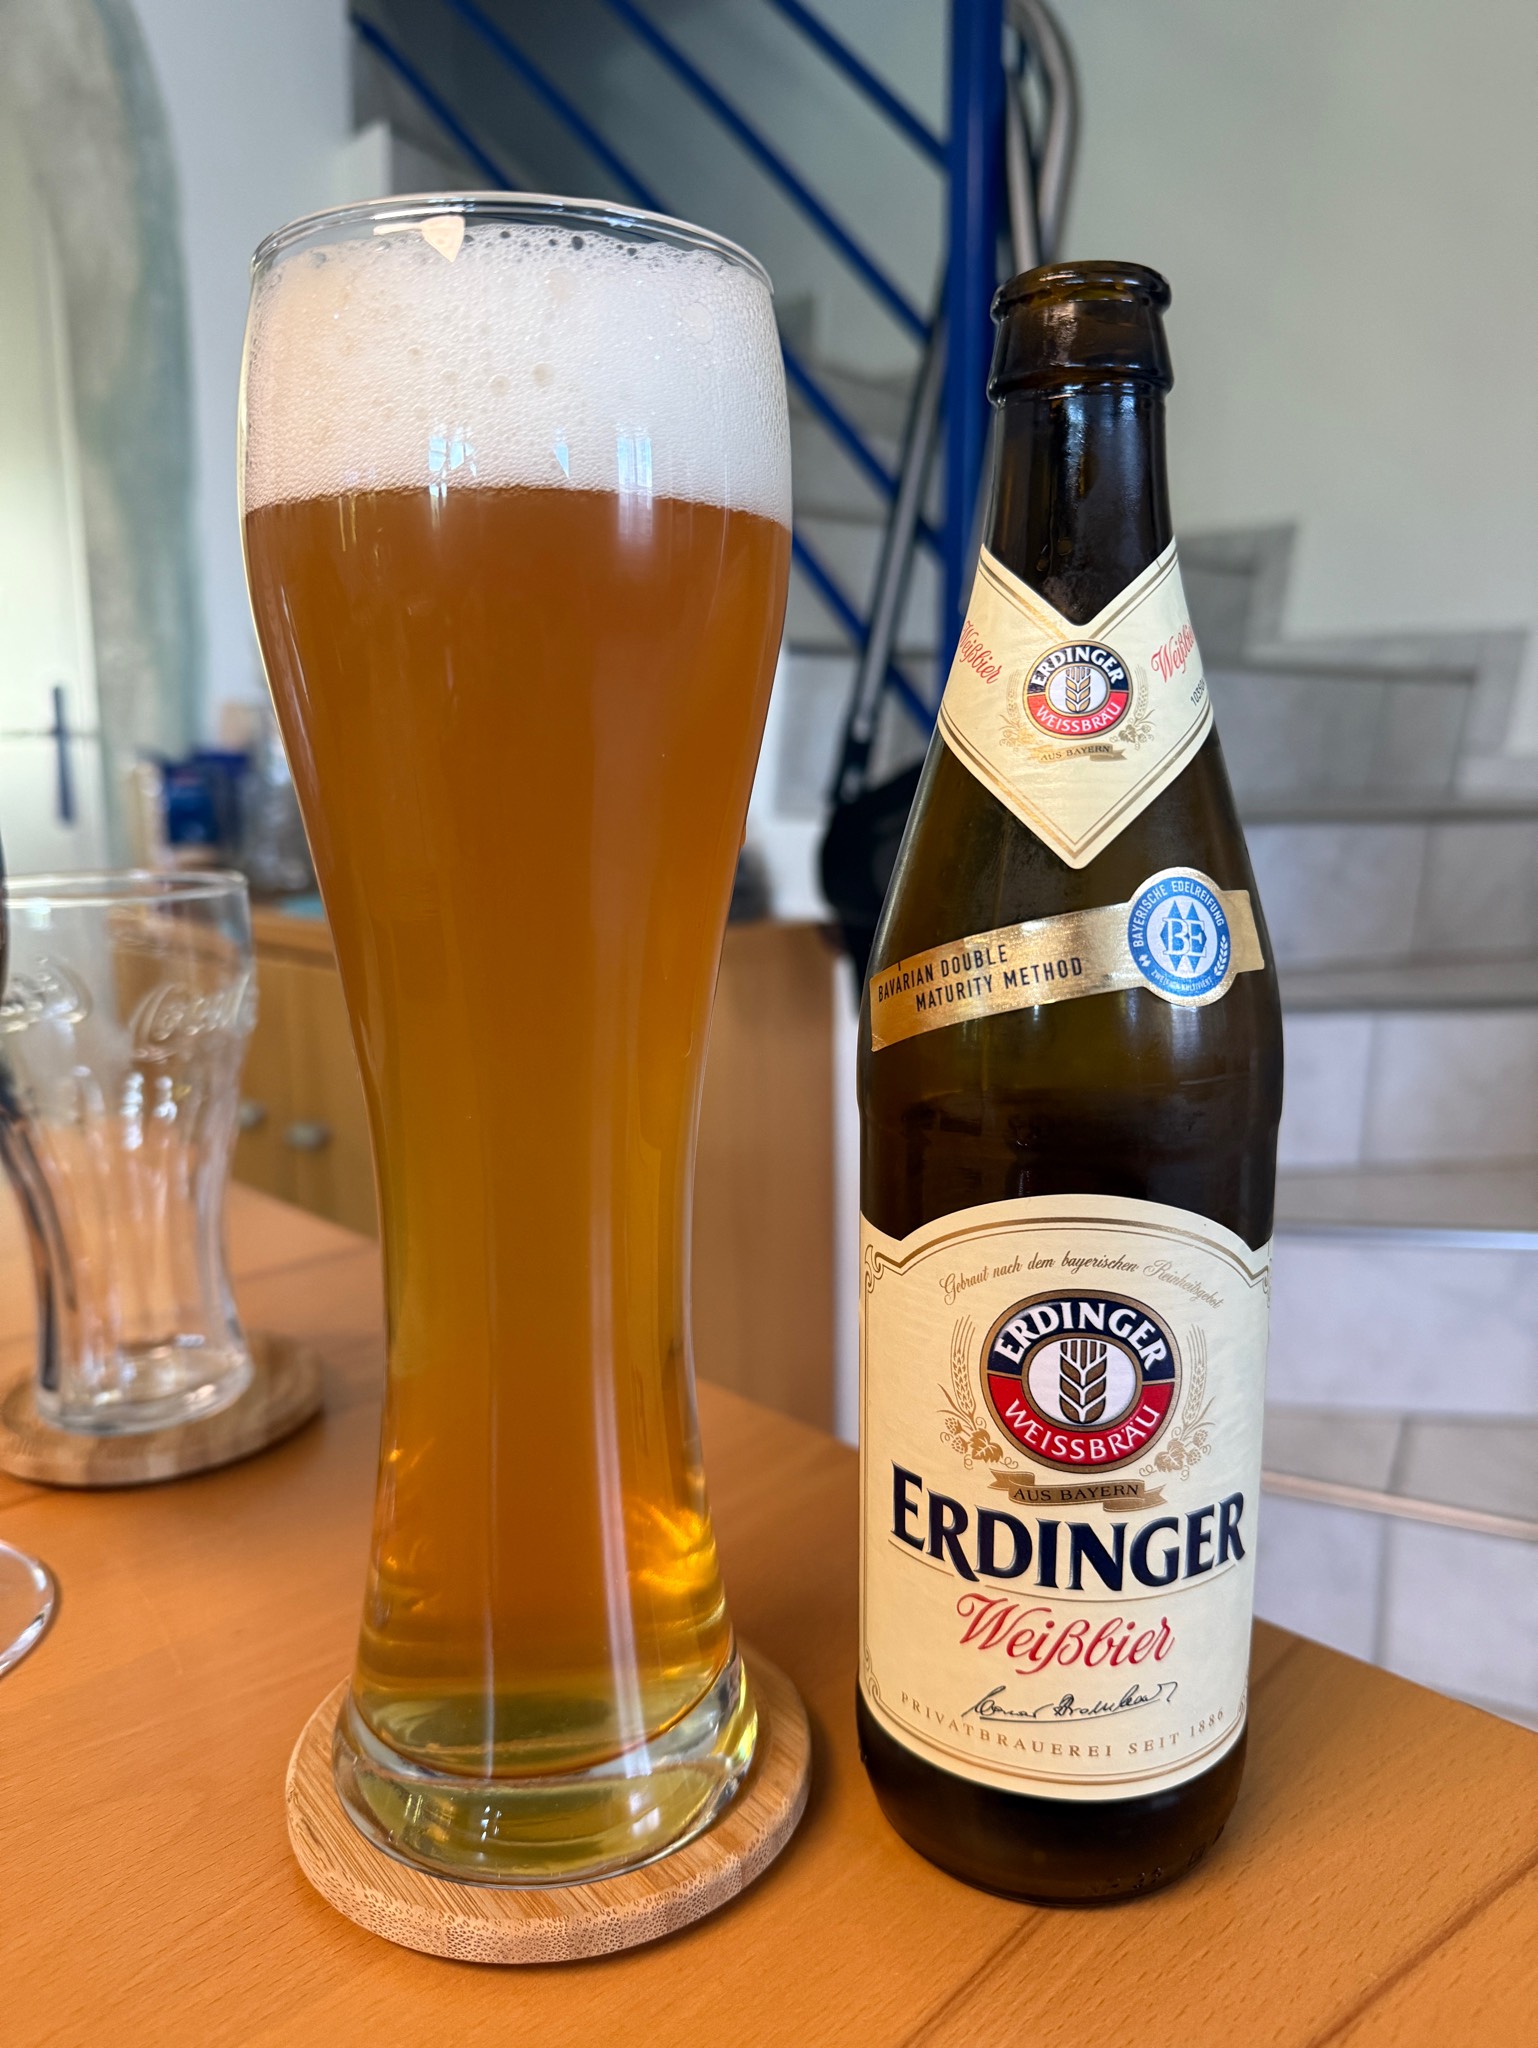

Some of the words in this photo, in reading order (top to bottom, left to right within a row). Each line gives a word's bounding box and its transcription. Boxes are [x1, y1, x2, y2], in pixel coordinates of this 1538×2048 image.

[1031, 646, 1125, 687] ERDINGER
[1036, 701, 1122, 733] WEISSBRÄU
[1040, 752, 1062, 761] AUS
[1066, 745, 1111, 757] BAYERN
[1132, 884, 1168, 948] BAYERISCHE
[1171, 880, 1225, 927] EDELREIFUNG
[1161, 917, 1207, 958] BE
[878, 963, 935, 1003] BAVARIAN
[940, 944, 1008, 978] DOUBLE
[915, 974, 995, 1012] MATURITY
[1003, 957, 1083, 990] METHOD
[939, 1265, 989, 1306] Gebraut
[993, 1255, 1024, 1279] nach
[1027, 1252, 1056, 1269] dem
[1061, 1250, 1140, 1275] bayerischen
[1142, 1260, 1225, 1309] Reinheitsgebot
[993, 1301, 1166, 1370] ERDINGER
[1005, 1399, 1160, 1461] WEISSBRÄU
[1013, 1488, 1051, 1501] AUS
[1060, 1484, 1140, 1501] BAYERN
[890, 1458, 1246, 1592] ERDINGER
[956, 1592, 1176, 1676] Weißbier
[900, 1691, 1112, 1758] PRIVATBRAUEREI
[1128, 1731, 1180, 1755] SEIT
[1189, 1708, 1225, 1738] 1886
